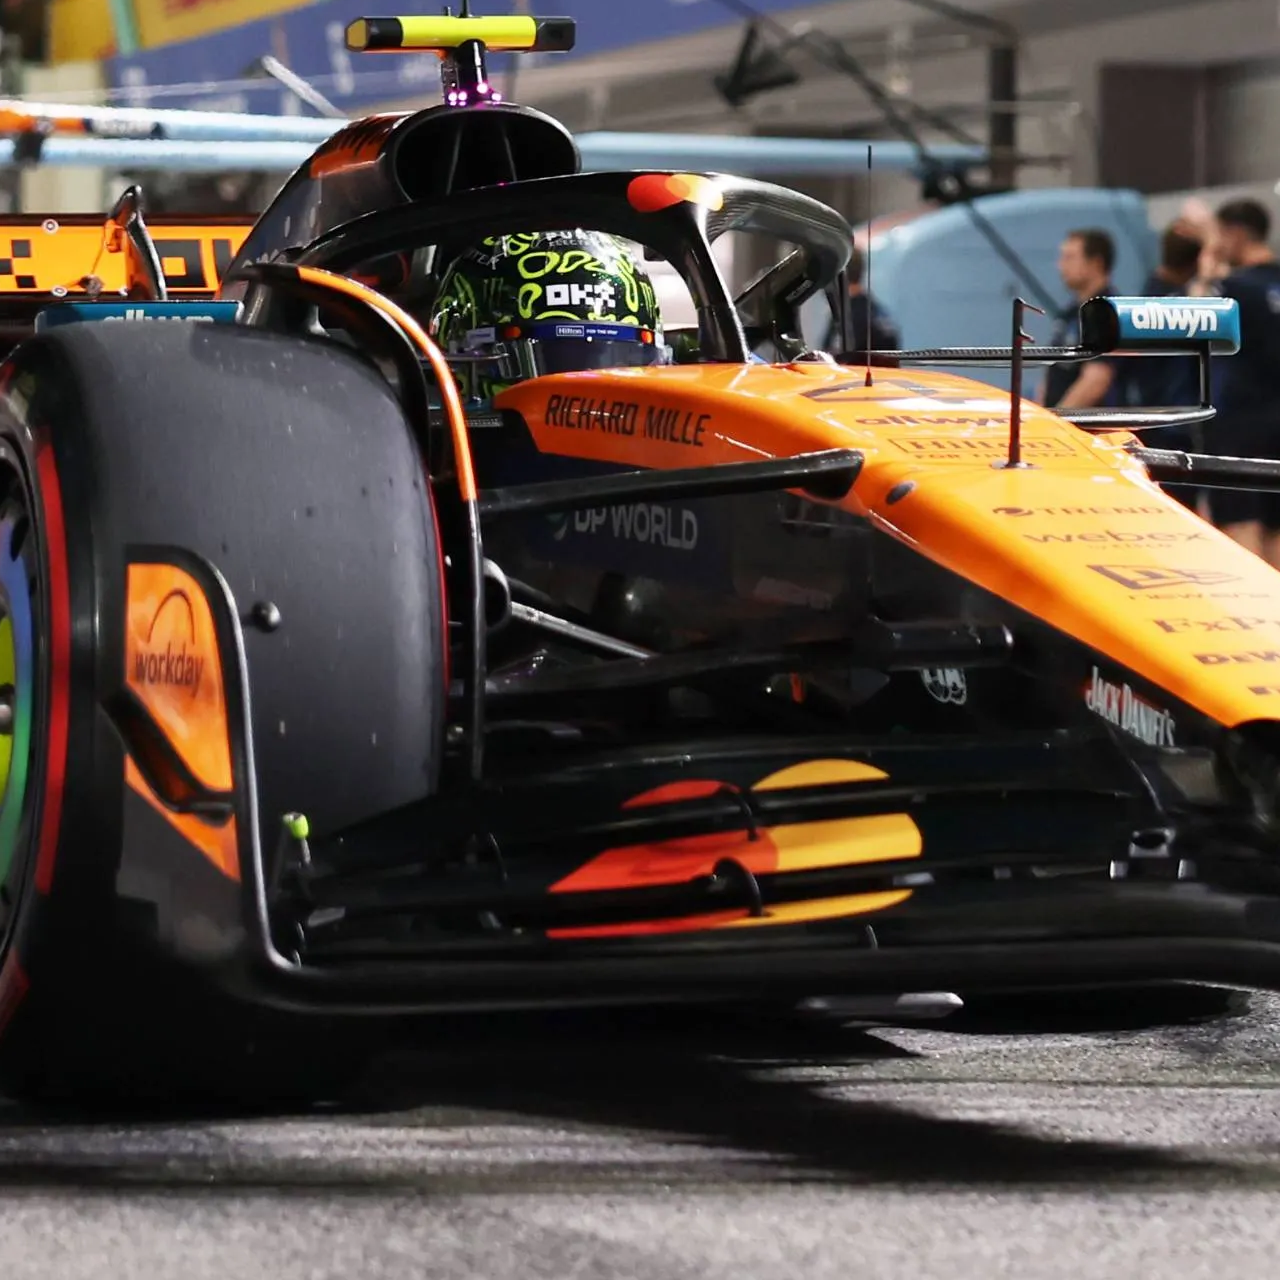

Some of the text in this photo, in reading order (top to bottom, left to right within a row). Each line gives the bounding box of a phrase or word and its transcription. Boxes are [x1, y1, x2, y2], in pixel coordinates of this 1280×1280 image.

[1131, 301, 1218, 338] allwyn
[545, 394, 712, 447] RICHARD MILLE
[611, 502, 698, 550] WORLD
[1022, 529, 1212, 544] webex
[135, 640, 204, 699] workday
[1085, 665, 1121, 726] JACK
